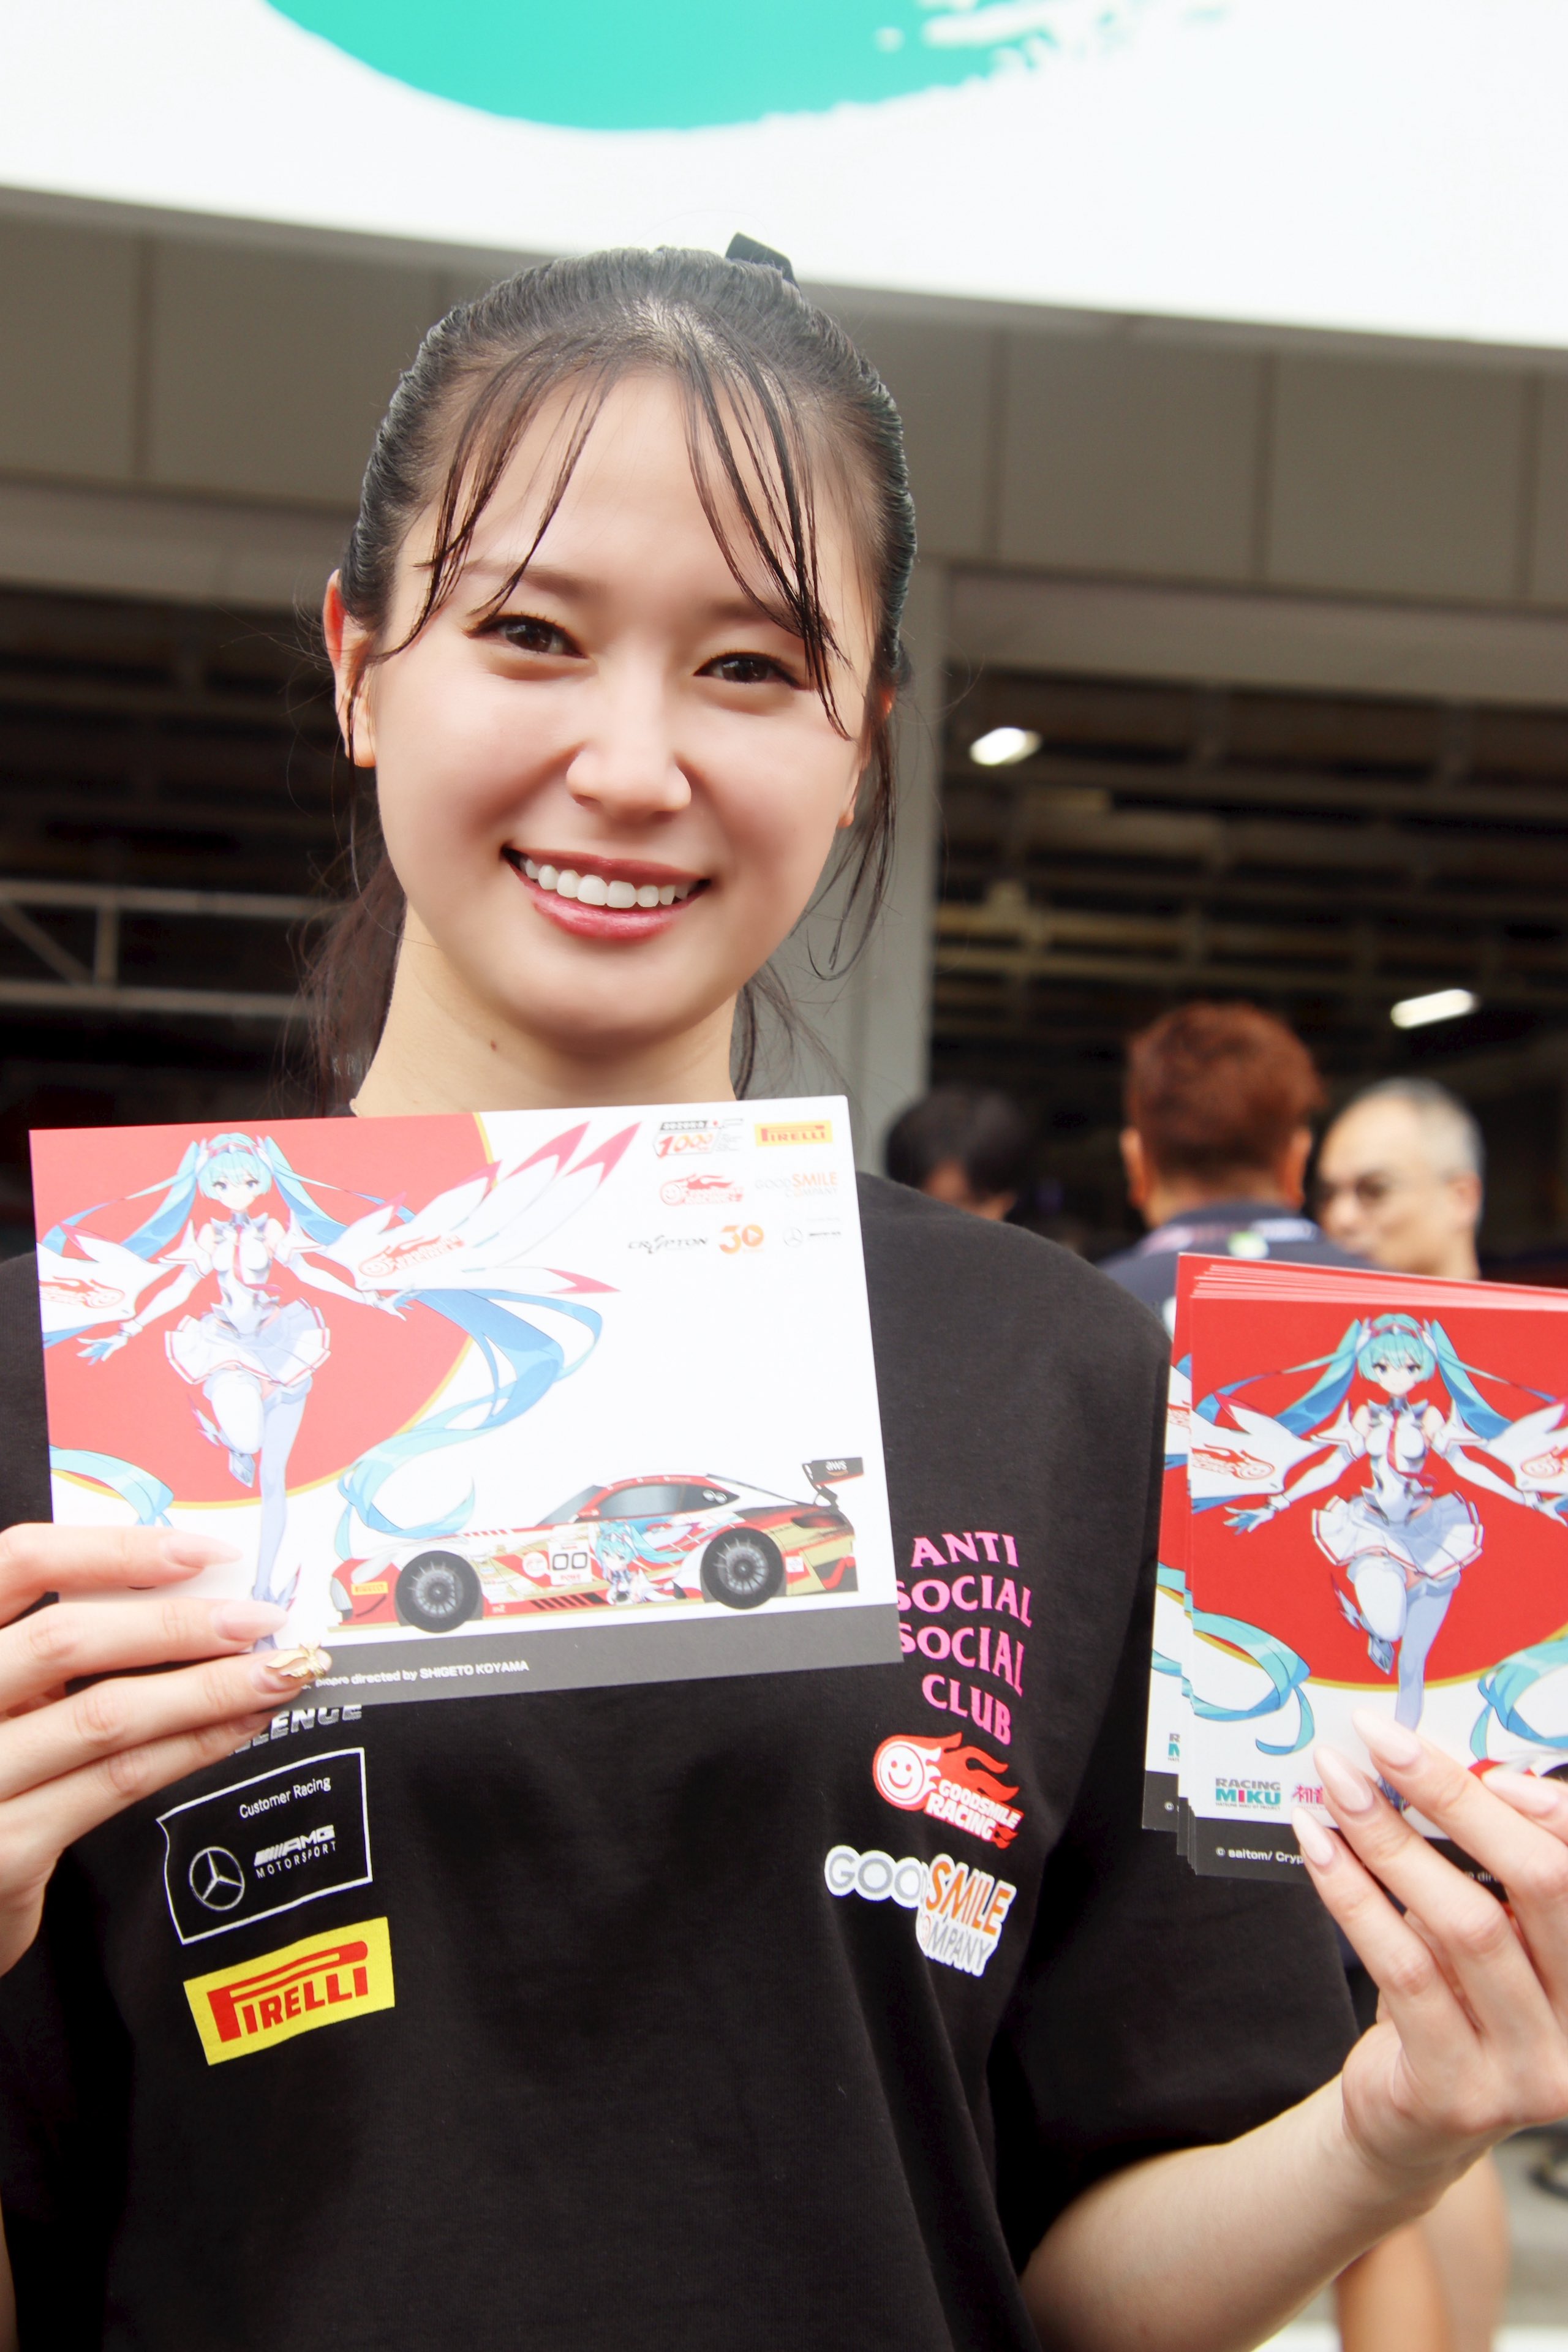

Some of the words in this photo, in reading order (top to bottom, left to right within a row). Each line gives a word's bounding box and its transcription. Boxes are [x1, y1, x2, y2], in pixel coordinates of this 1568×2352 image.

[761, 1125, 826, 1142] PIRELLI
[911, 1531, 1019, 1567] ANTI
[897, 1575, 1032, 1628] SOCIAL
[351, 1672, 401, 1684] directed
[402, 1669, 418, 1681] by
[419, 1664, 474, 1679] SHIGETO
[475, 1660, 529, 1675] KOYAMA
[899, 1621, 1024, 1697] SOCIAL
[921, 1673, 1011, 1745] CLUB
[239, 1790, 292, 1819] Customer
[293, 1777, 331, 1799] Racing
[938, 1779, 1022, 1830] GOODSMILE
[1215, 1777, 1281, 1791] RACING
[1215, 1788, 1281, 1805] MIKU
[925, 1792, 997, 1841] RACING
[255, 1841, 336, 1879] MOTORSPORT
[1275, 1851, 1304, 1865] Cryp
[919, 1912, 992, 1970] OMPANY
[207, 1940, 368, 2043] PIRELLI
